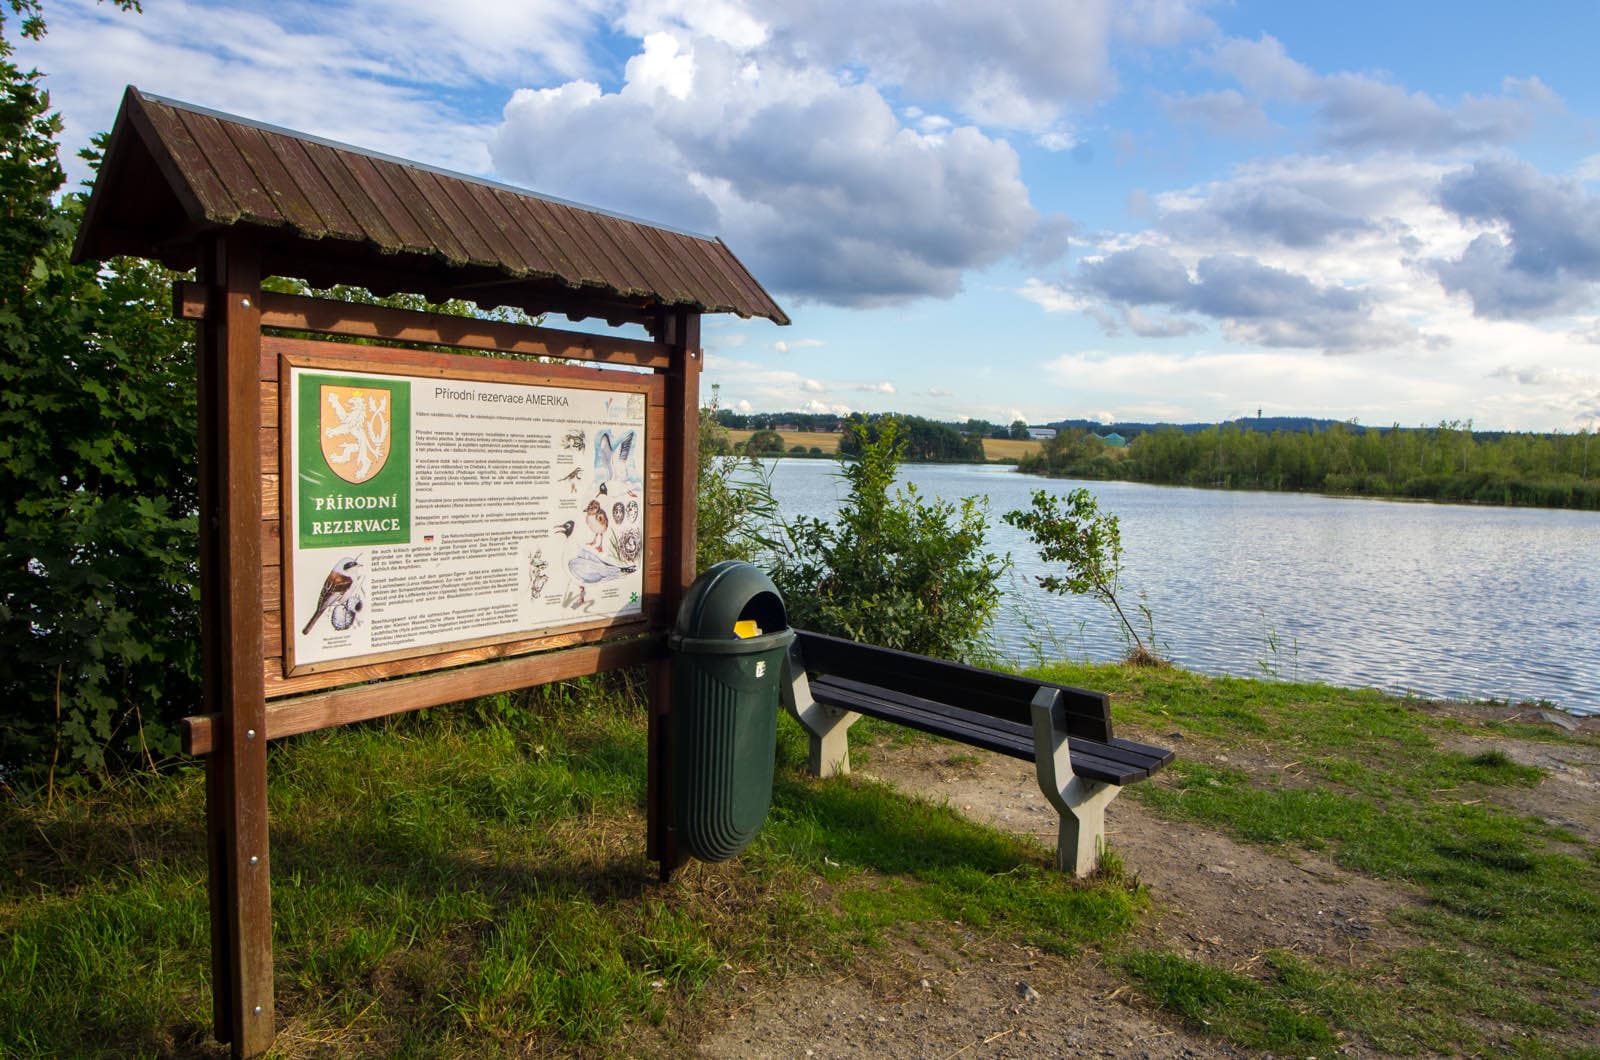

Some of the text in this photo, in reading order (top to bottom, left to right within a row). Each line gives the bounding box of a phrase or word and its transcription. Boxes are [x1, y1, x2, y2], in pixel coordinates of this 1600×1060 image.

[435, 387, 569, 407] Přírodní rezervace AMERIKA
[312, 518, 400, 535] REZERVACE
